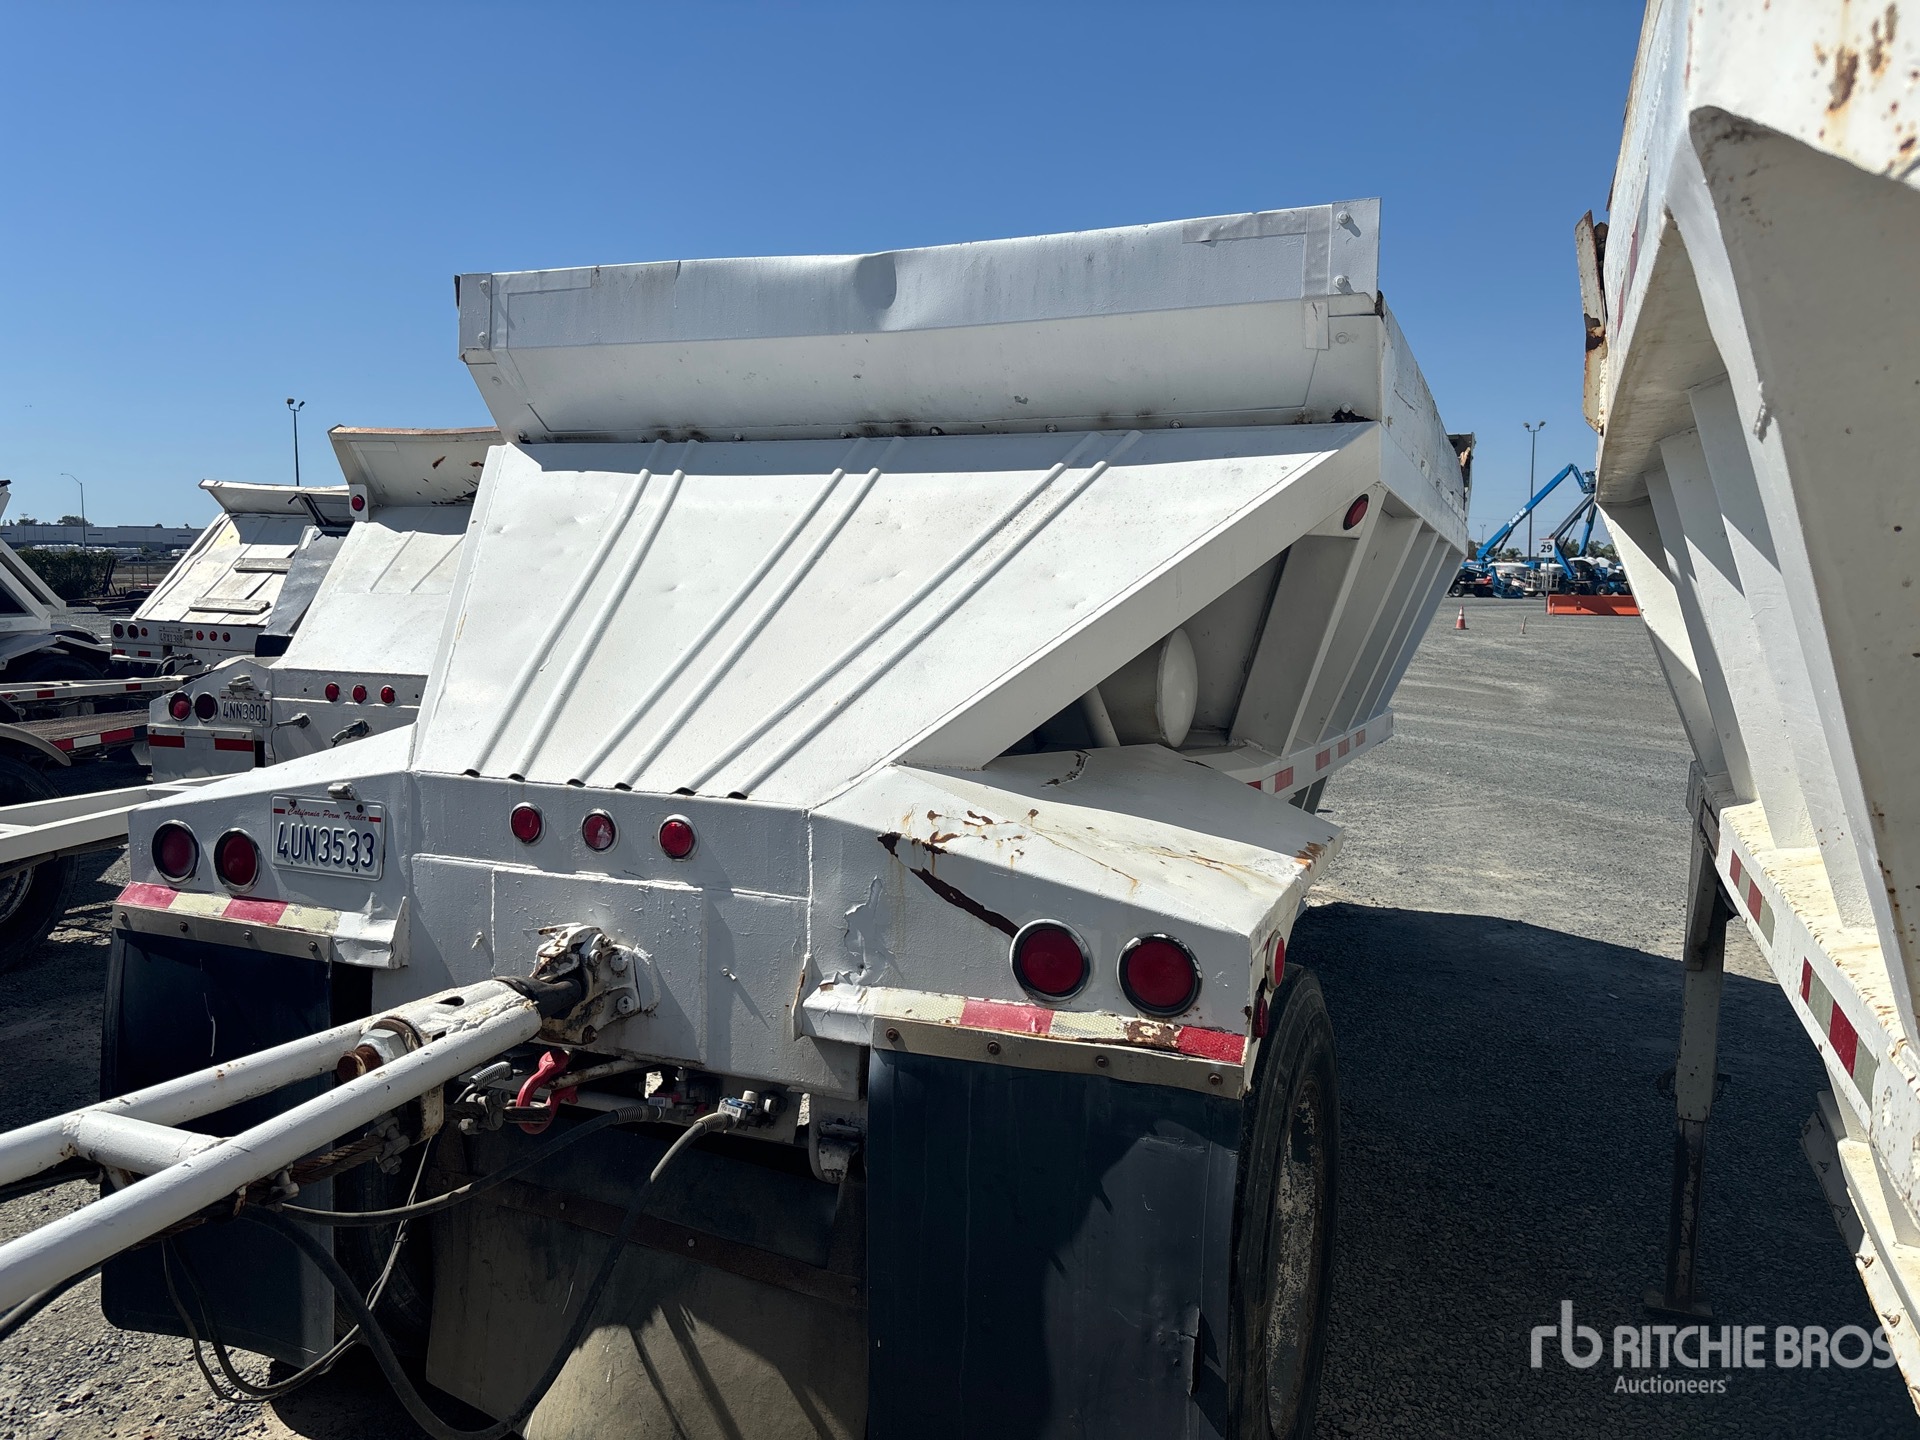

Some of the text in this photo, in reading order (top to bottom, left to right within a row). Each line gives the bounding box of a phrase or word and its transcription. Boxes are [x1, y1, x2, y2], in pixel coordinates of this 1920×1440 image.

[1540, 544, 1553, 553] 29
[223, 701, 267, 721] 4NN3801
[288, 807, 367, 821] California Perm Trailer
[277, 822, 374, 868] 4UN3533
